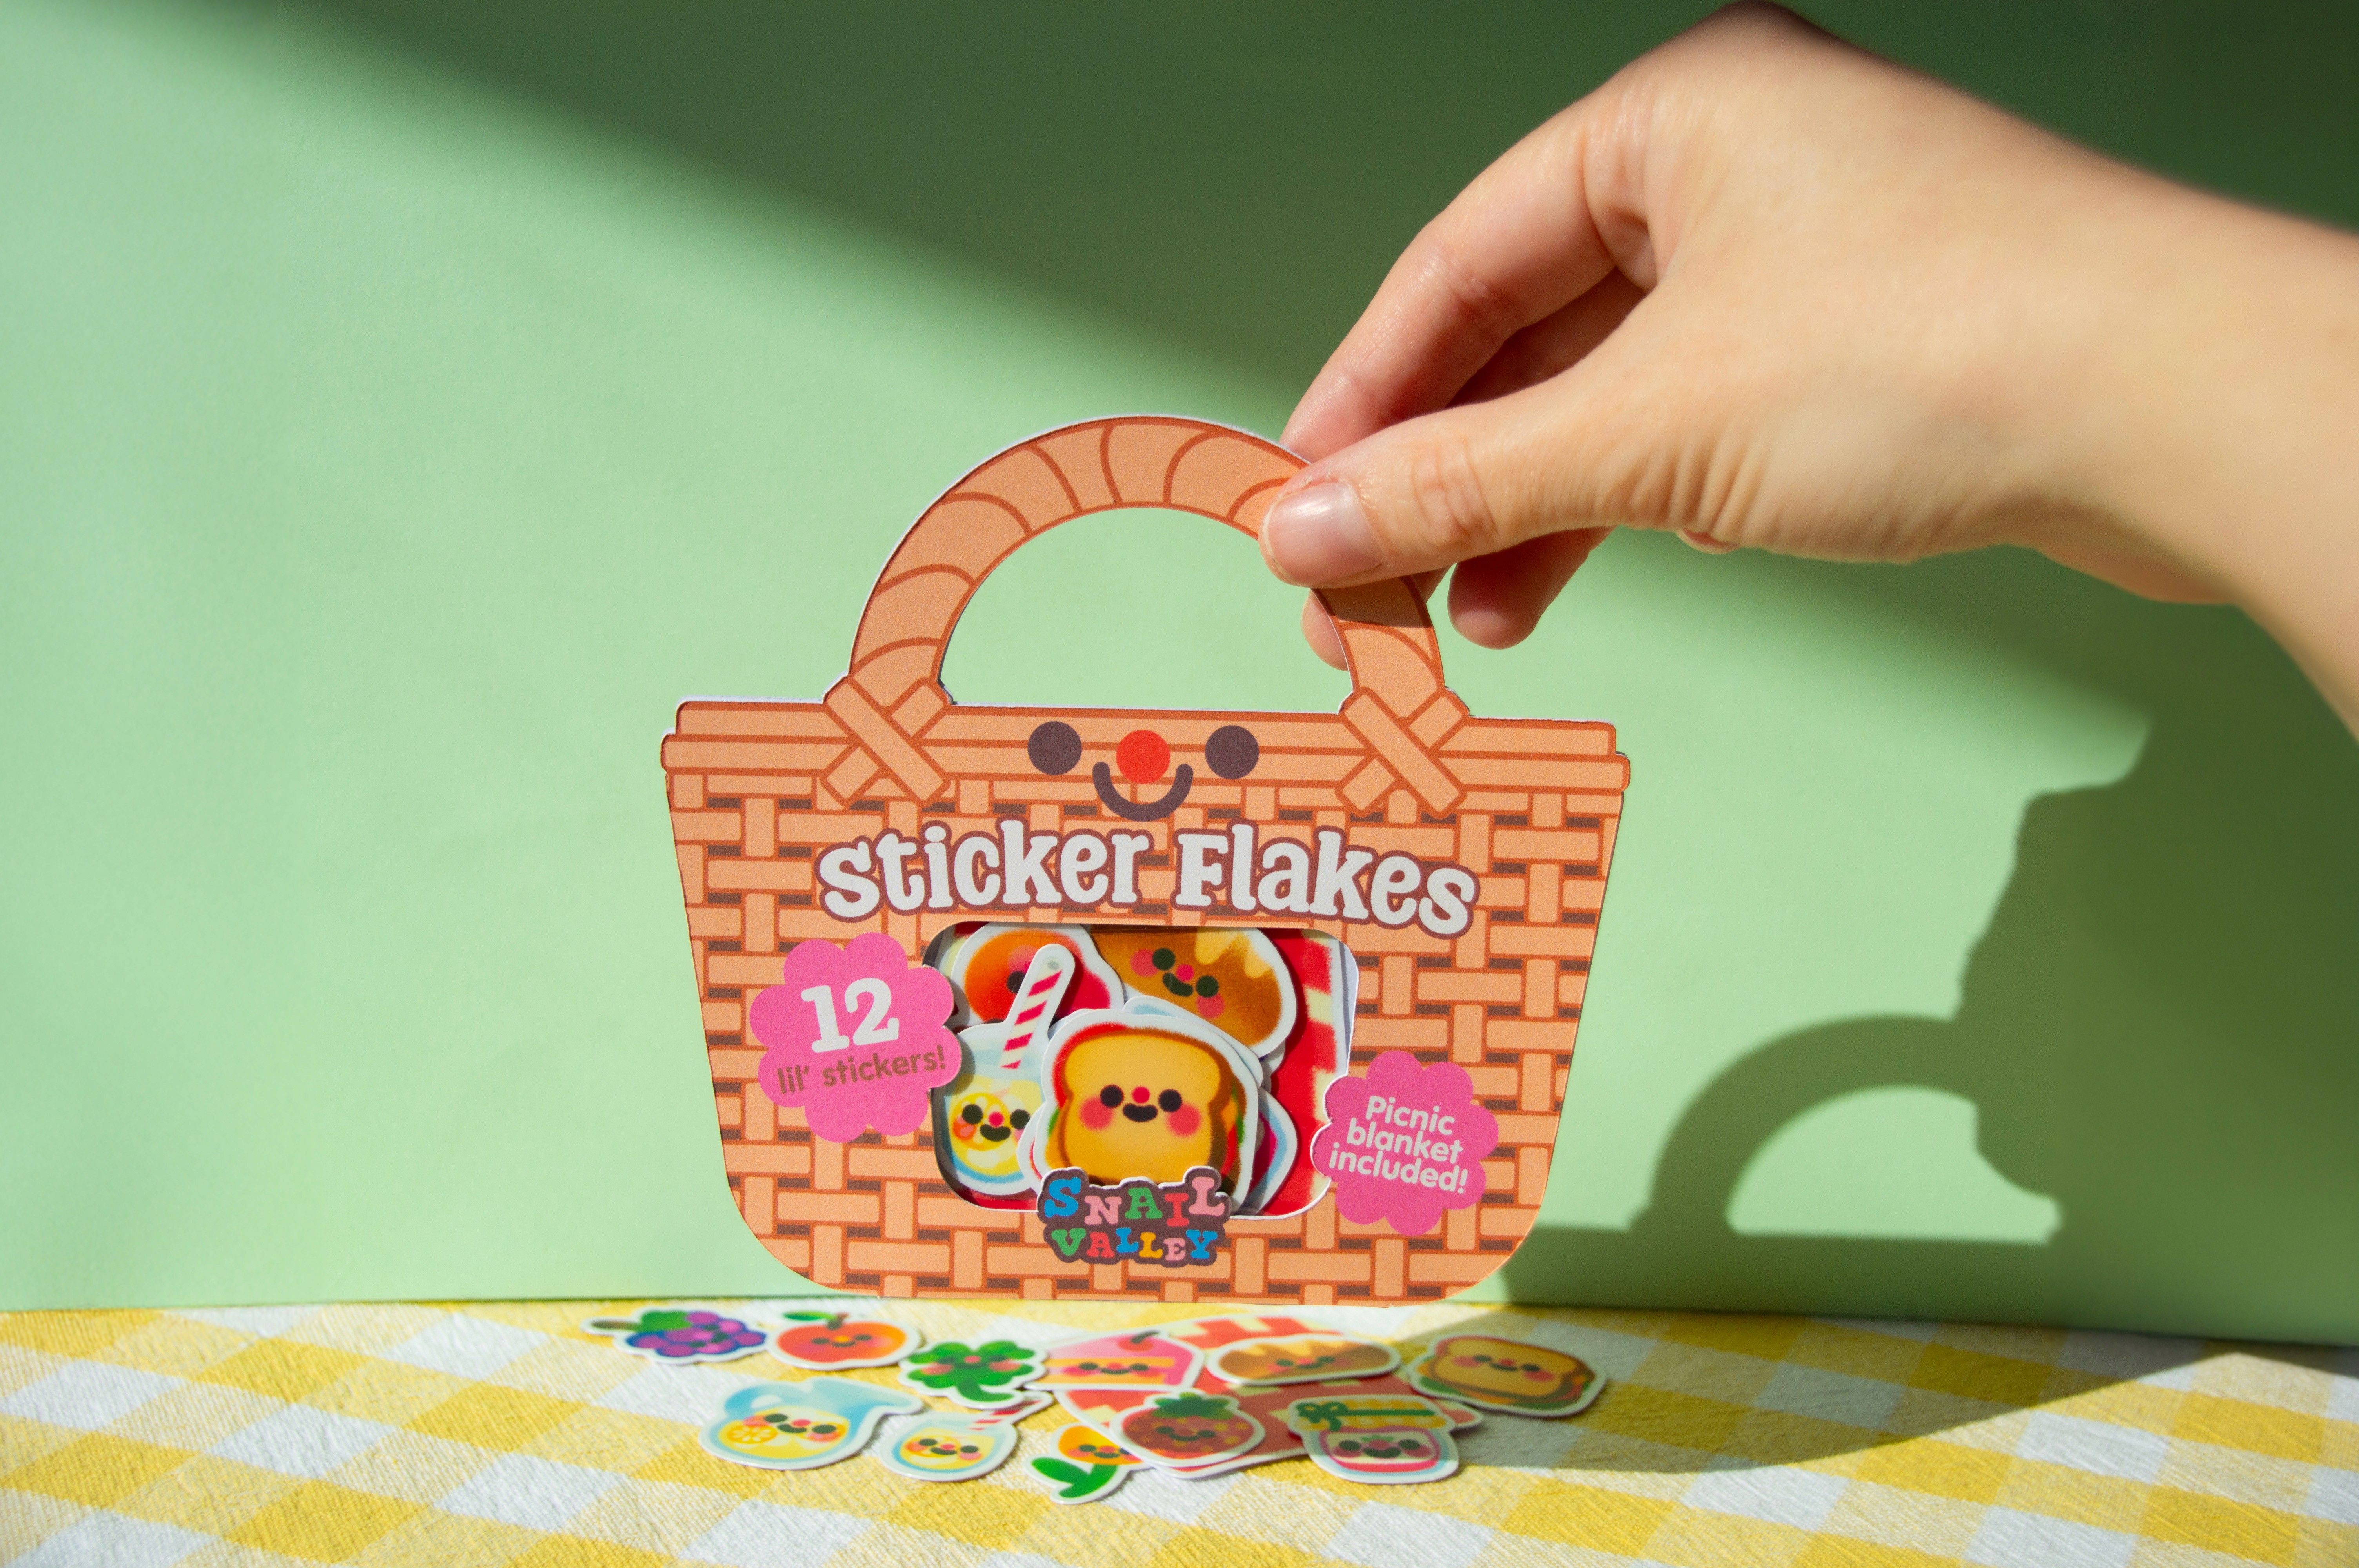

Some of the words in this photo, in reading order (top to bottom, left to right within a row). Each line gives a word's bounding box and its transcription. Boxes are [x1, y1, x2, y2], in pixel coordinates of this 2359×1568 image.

[818, 819, 1150, 918] Sticker
[1175, 823, 1476, 935] Flakes
[801, 978, 899, 1053] 12
[823, 1044, 946, 1088] stickers!
[1365, 1095, 1455, 1135] Picnic
[1346, 1118, 1463, 1164] blanket
[1329, 1142, 1468, 1194] included!
[1044, 1176, 1225, 1227] SNAIL
[1051, 1227, 1218, 1261] VALLEY
